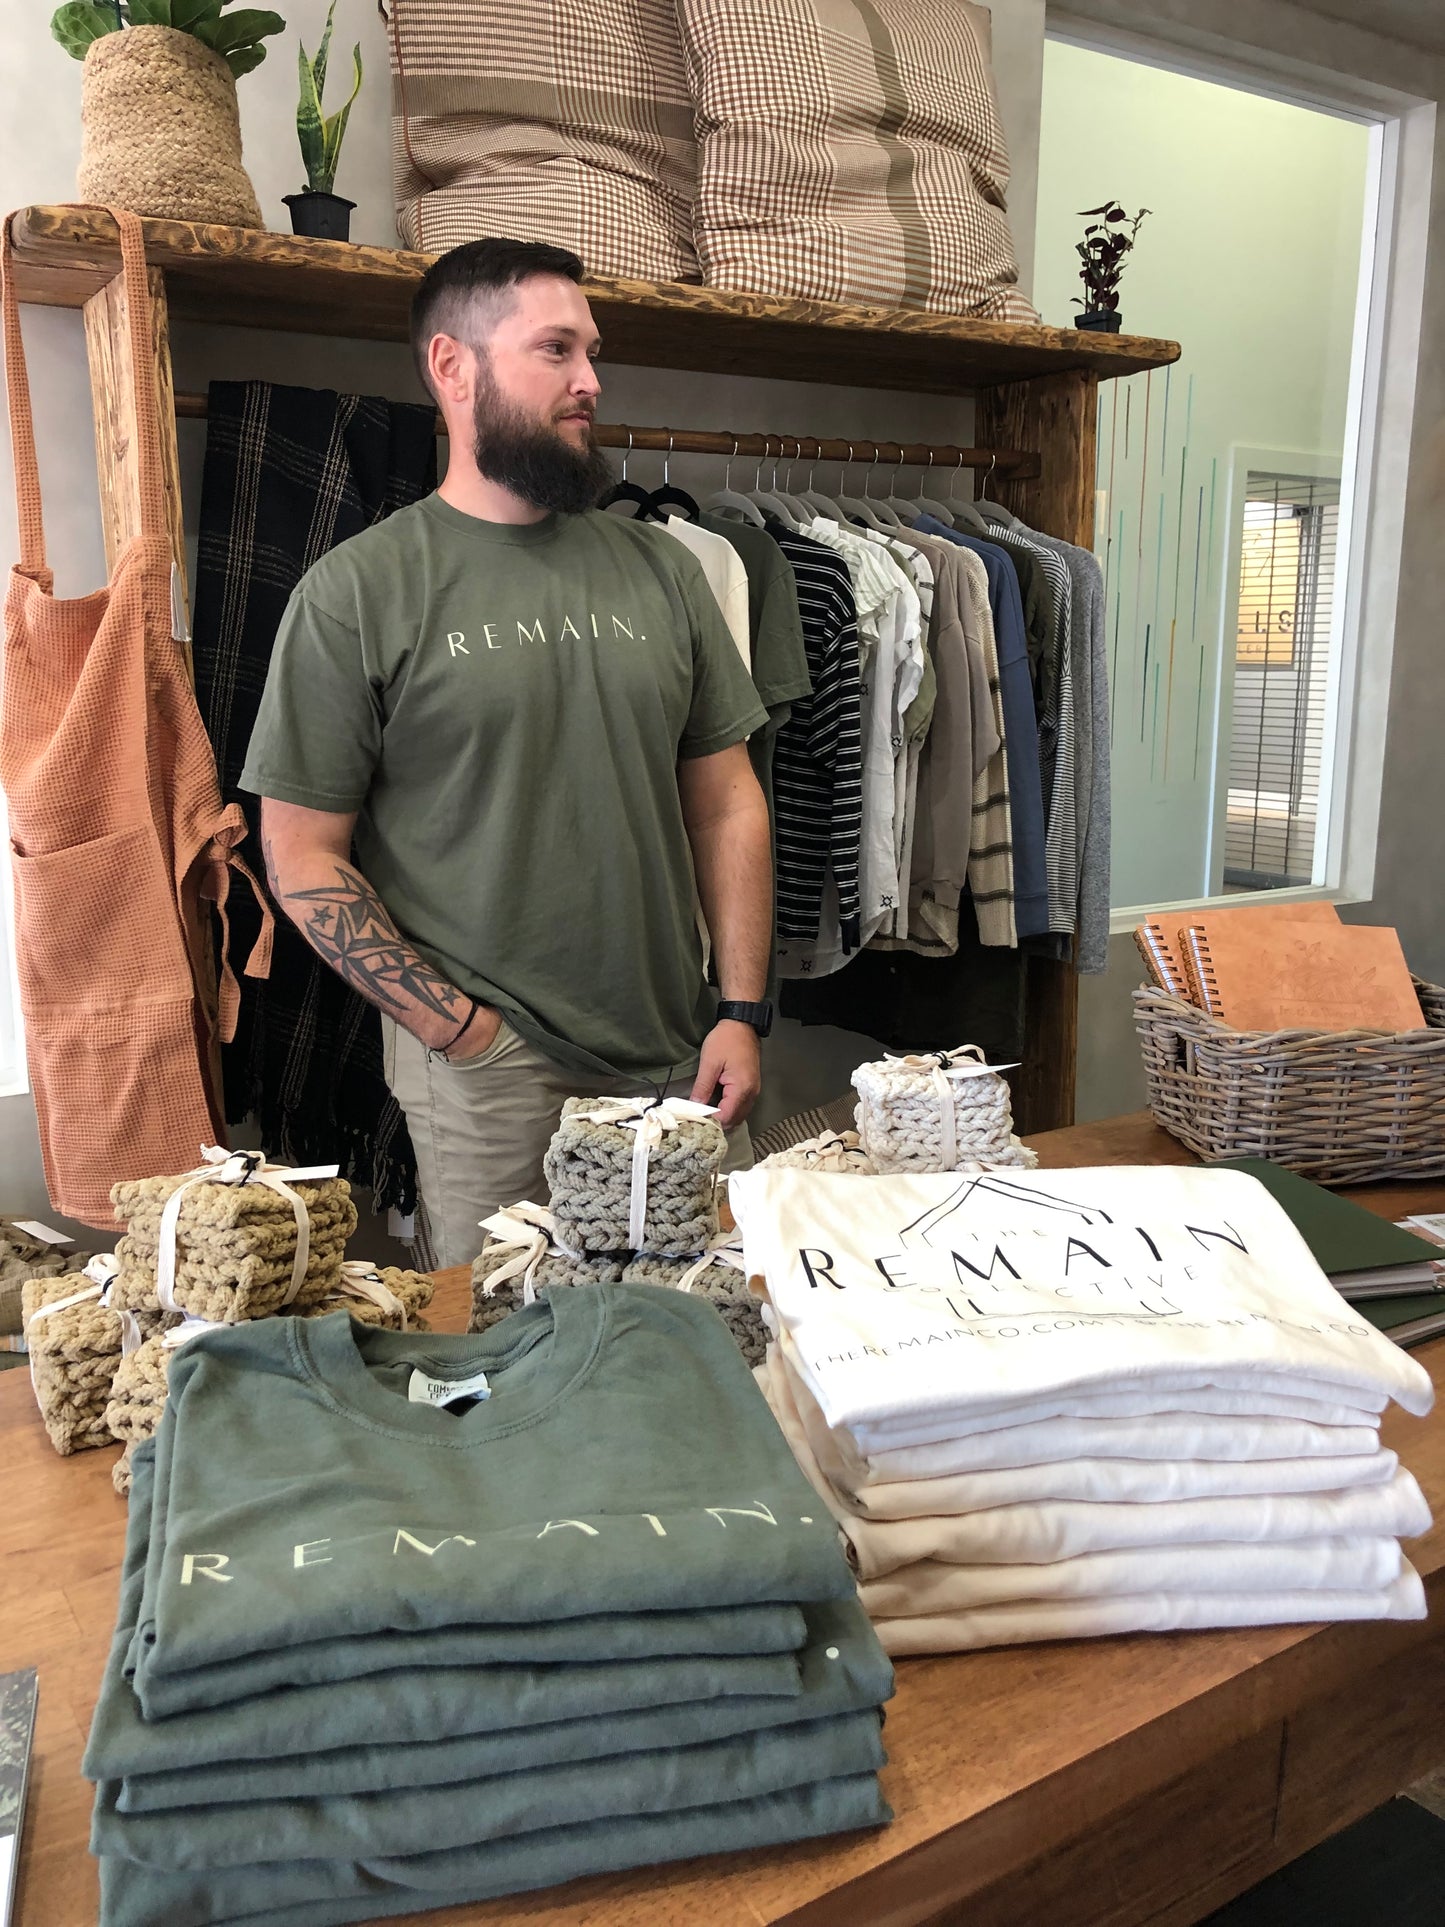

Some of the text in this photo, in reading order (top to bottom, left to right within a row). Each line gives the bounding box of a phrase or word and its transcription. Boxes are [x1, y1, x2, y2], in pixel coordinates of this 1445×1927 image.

[446, 613, 647, 657] REMAIN.
[797, 1220, 1250, 1290] REMAIN
[968, 1228, 1048, 1242] THE
[179, 1499, 814, 1585] REMAIN.
